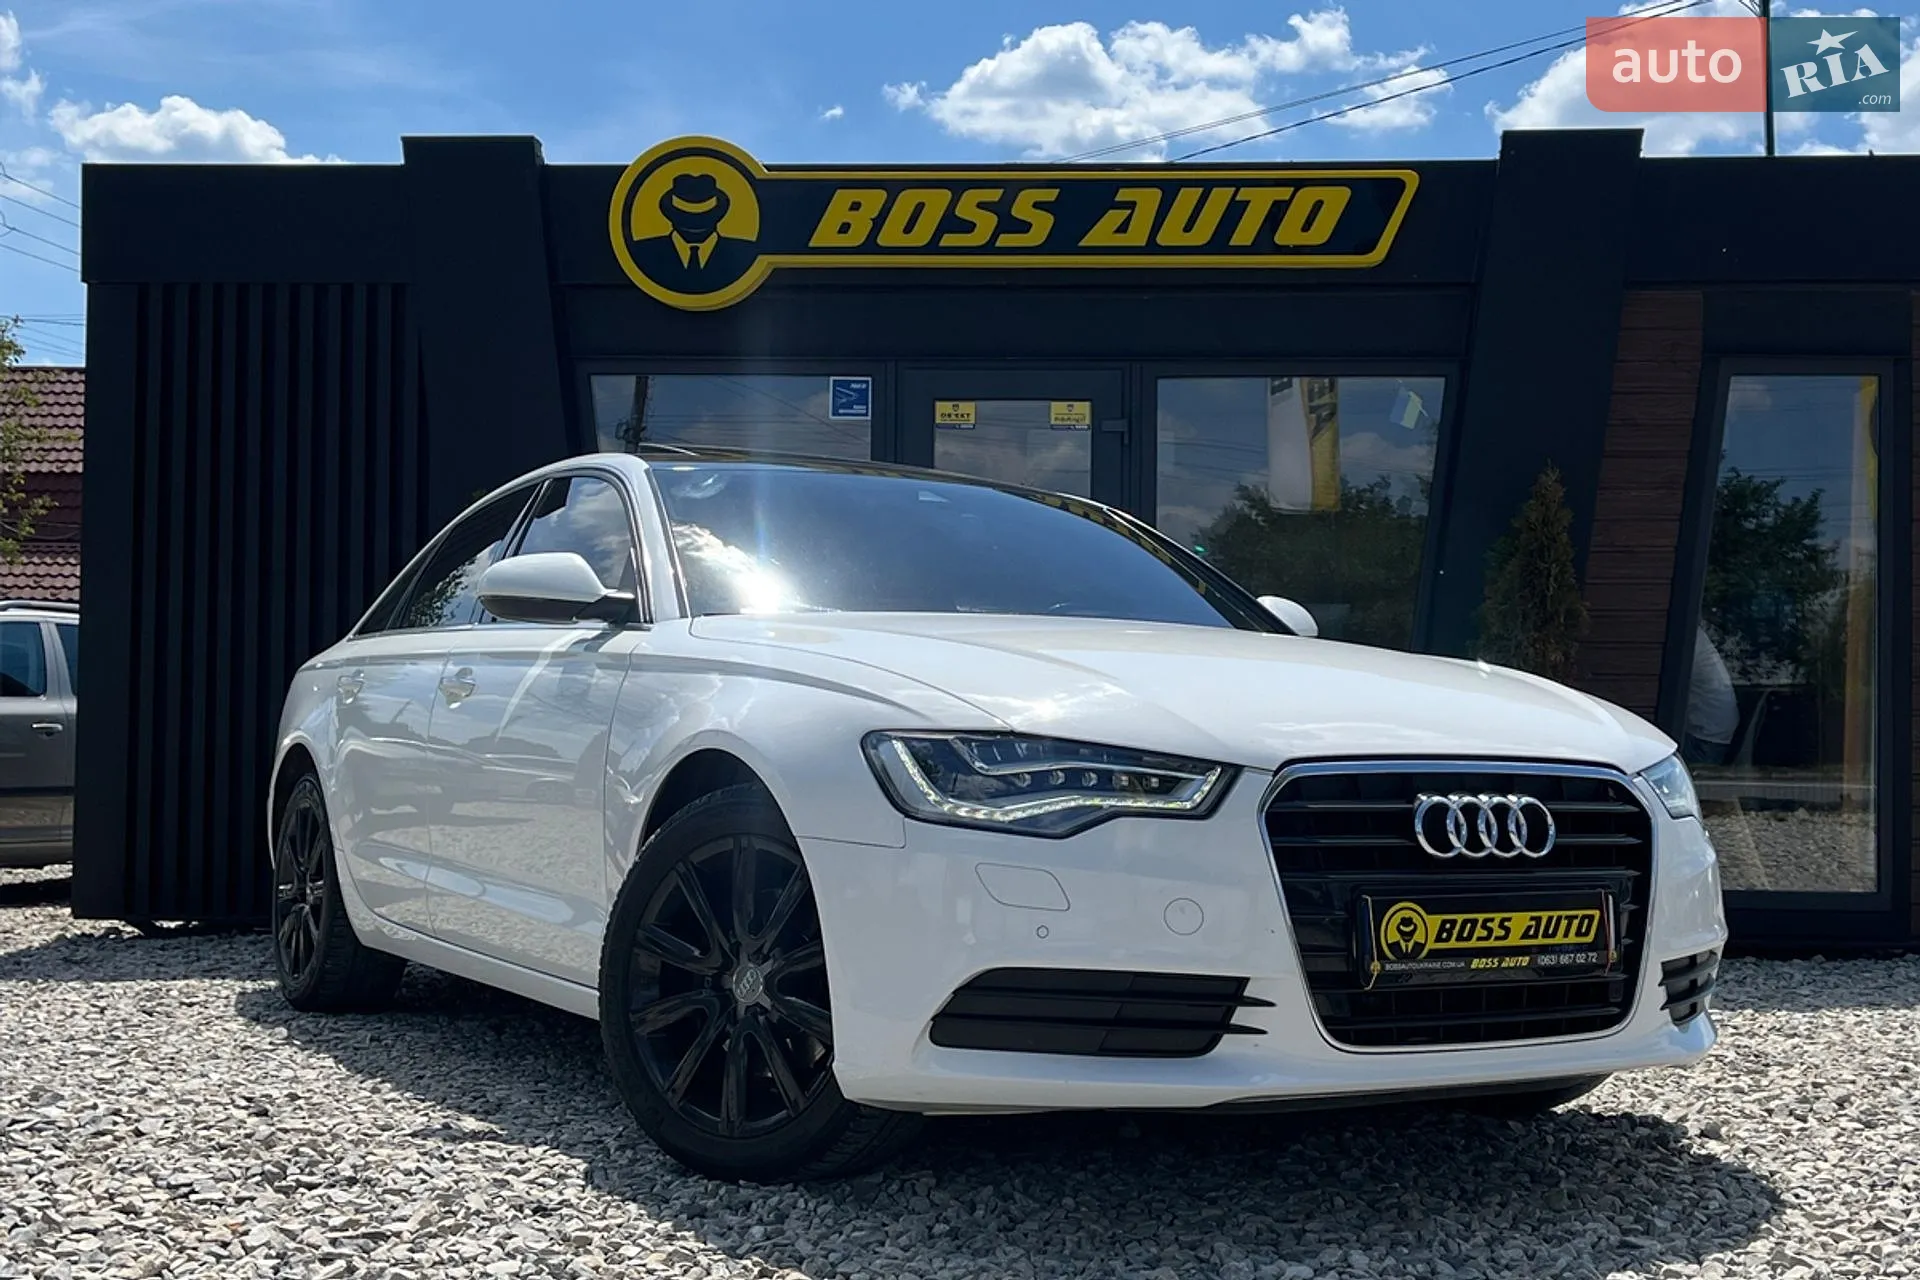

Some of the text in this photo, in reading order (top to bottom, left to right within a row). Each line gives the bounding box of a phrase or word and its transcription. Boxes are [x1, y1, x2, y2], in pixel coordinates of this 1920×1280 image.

[808, 186, 1353, 248] BOSS AUTO
[1434, 913, 1596, 943] BOSS AUTO
[1470, 957, 1500, 969] BOSS
[1501, 955, 1531, 968] AUTO
[1576, 953, 1586, 964] 02
[1587, 952, 1598, 963] 72
